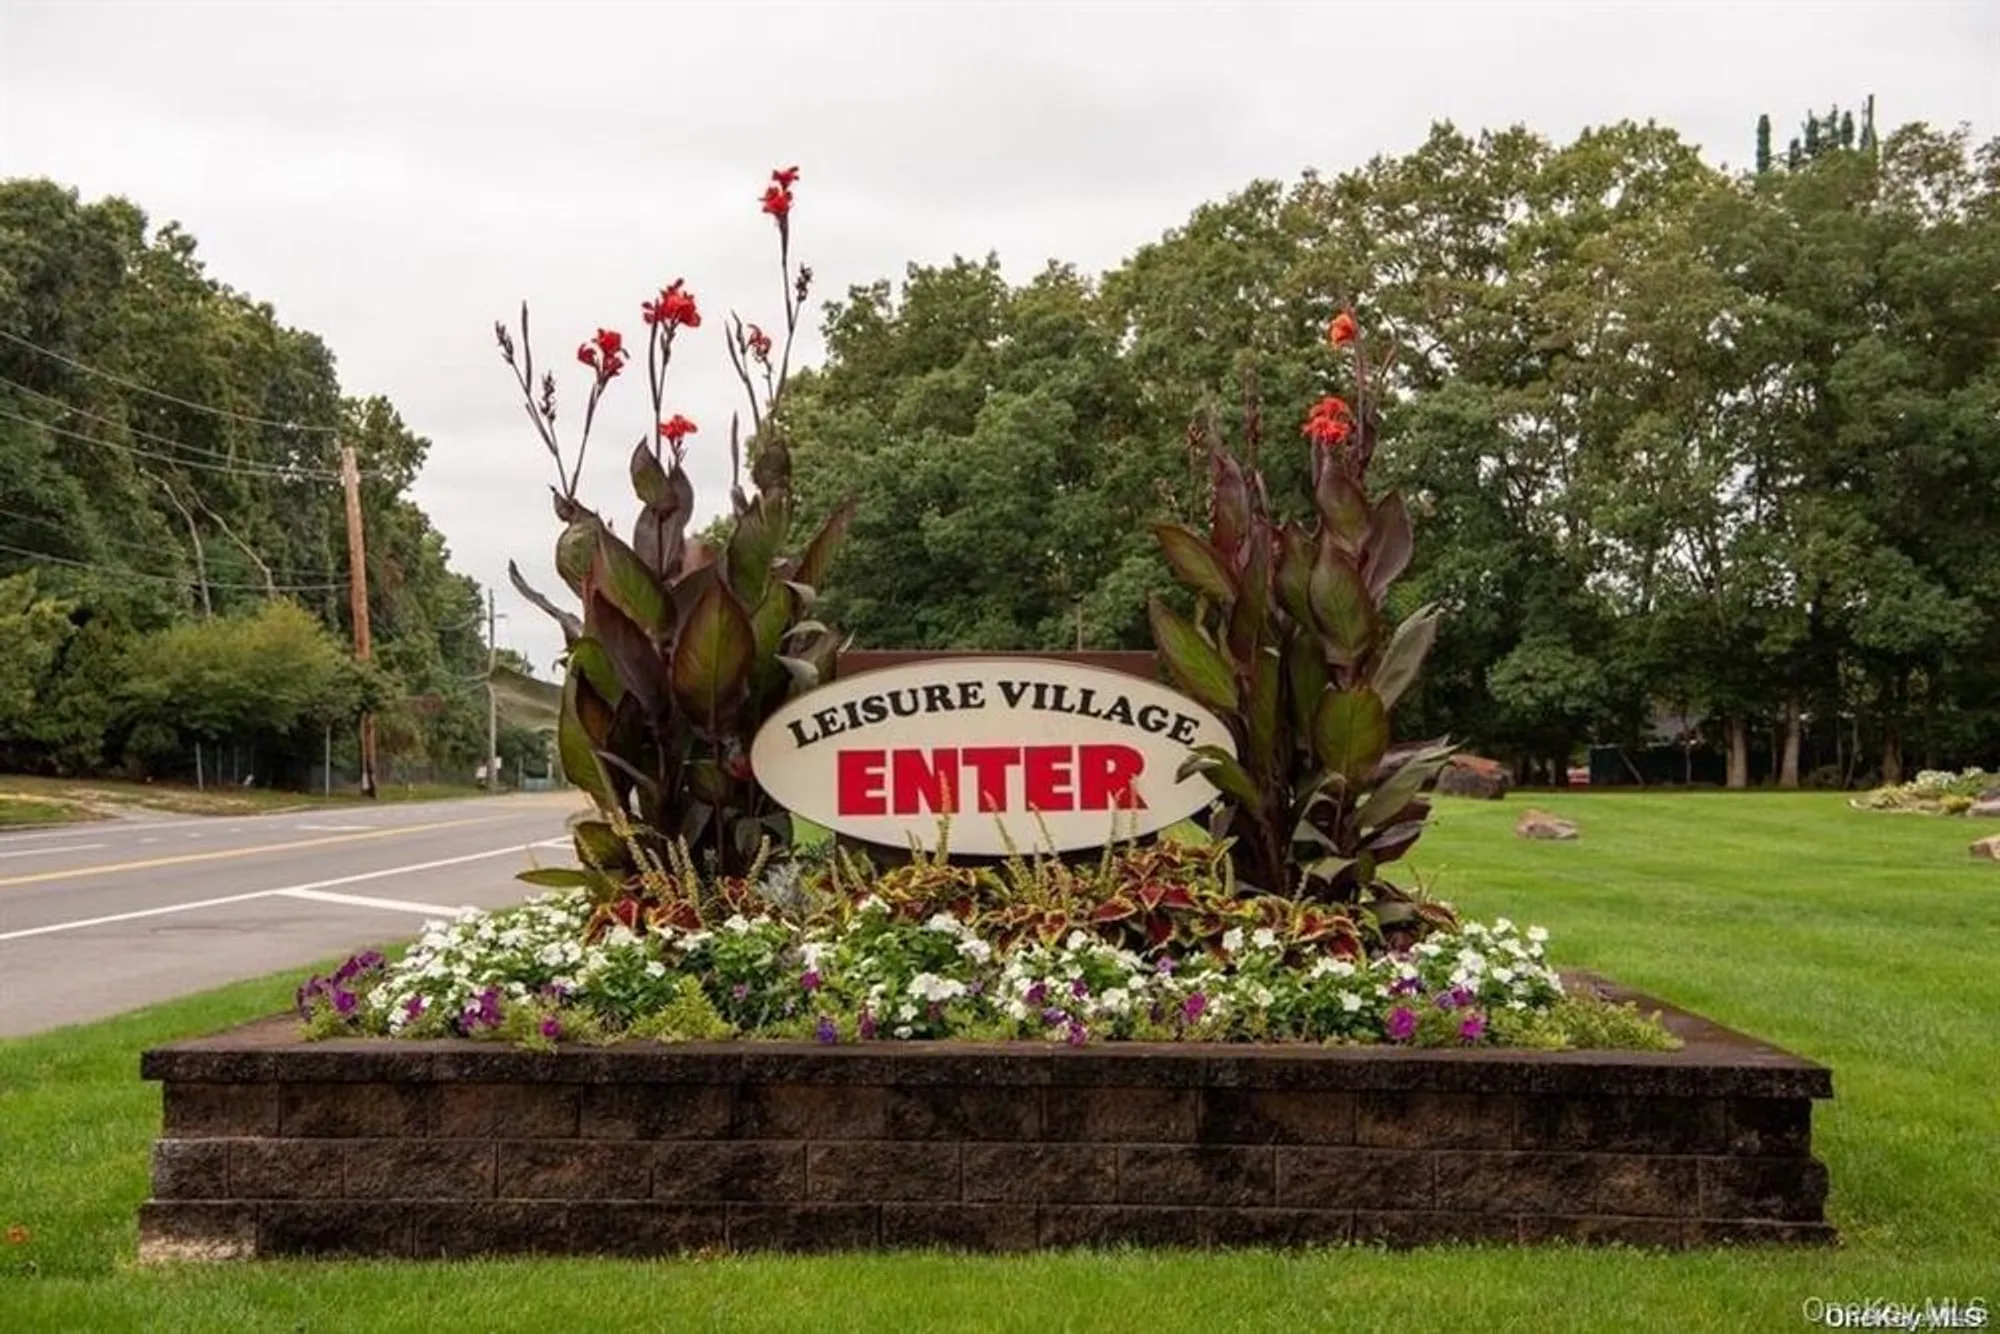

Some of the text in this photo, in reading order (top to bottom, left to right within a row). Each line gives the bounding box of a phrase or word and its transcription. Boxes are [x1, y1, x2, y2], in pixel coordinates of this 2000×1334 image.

[787, 681, 1200, 748] LEISURE VILLAGE
[837, 744, 1149, 816] ENTER
